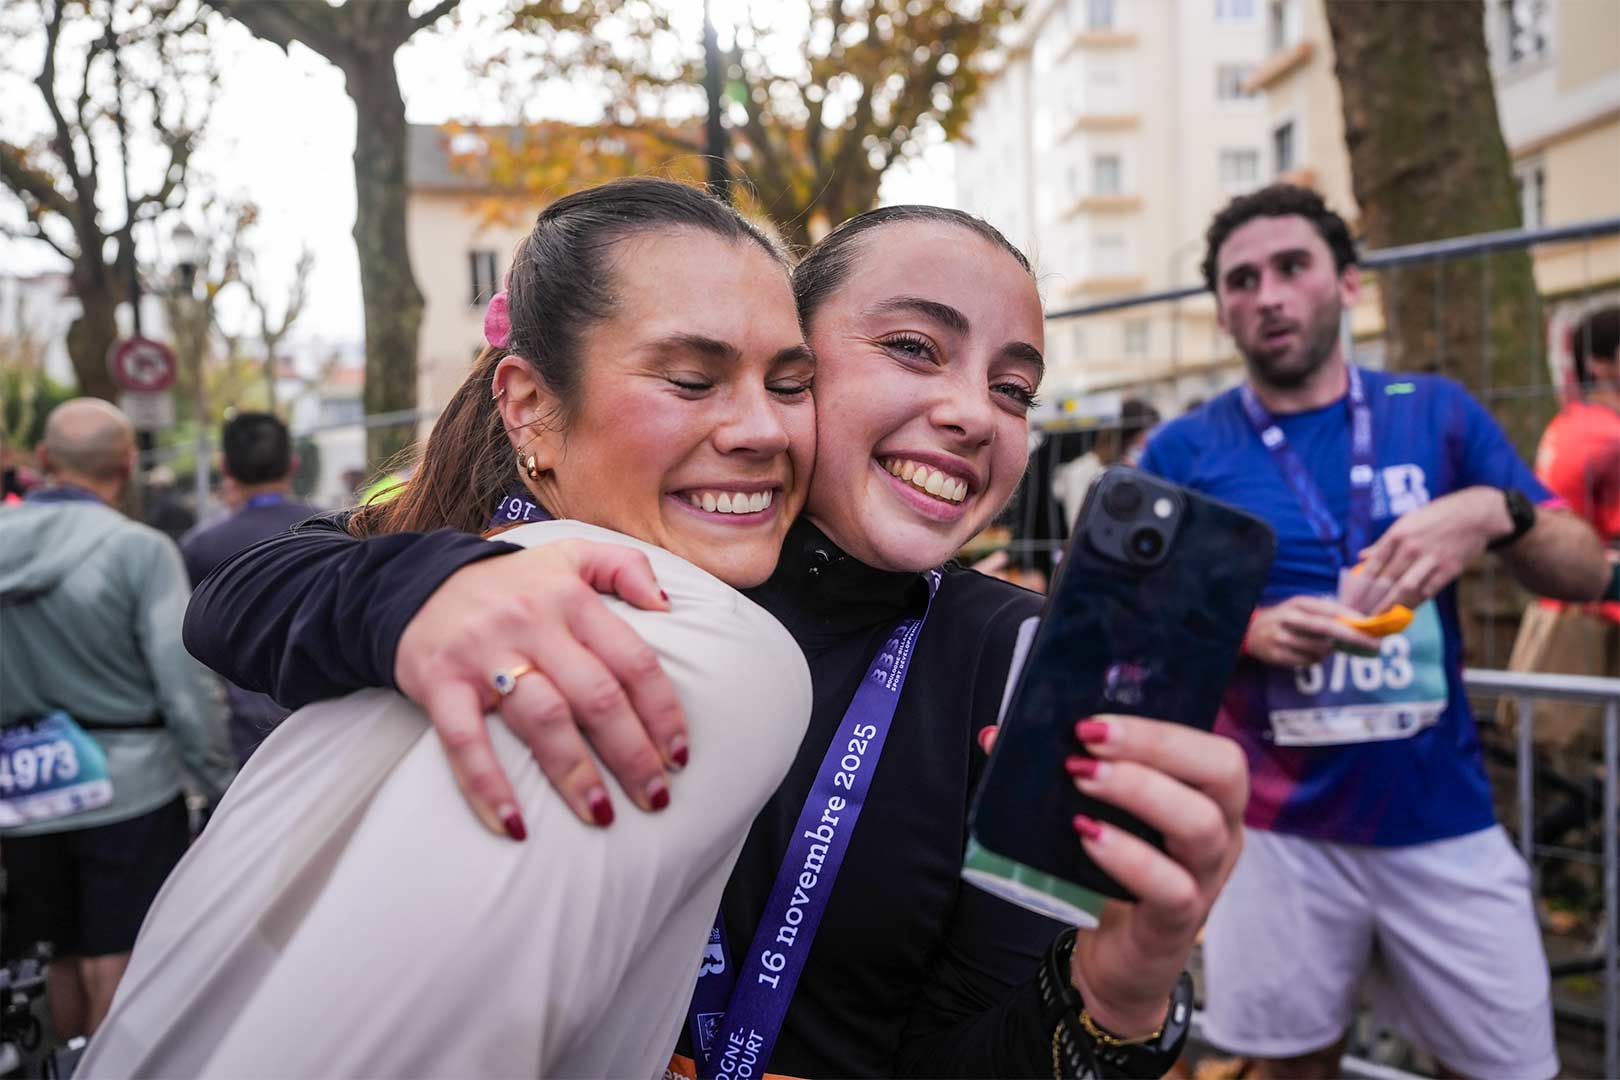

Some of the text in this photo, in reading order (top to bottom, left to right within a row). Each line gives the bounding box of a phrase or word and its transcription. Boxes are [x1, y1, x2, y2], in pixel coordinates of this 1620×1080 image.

[891, 671, 902, 691] SPORT
[758, 723, 876, 989] 16 novembre 2025
